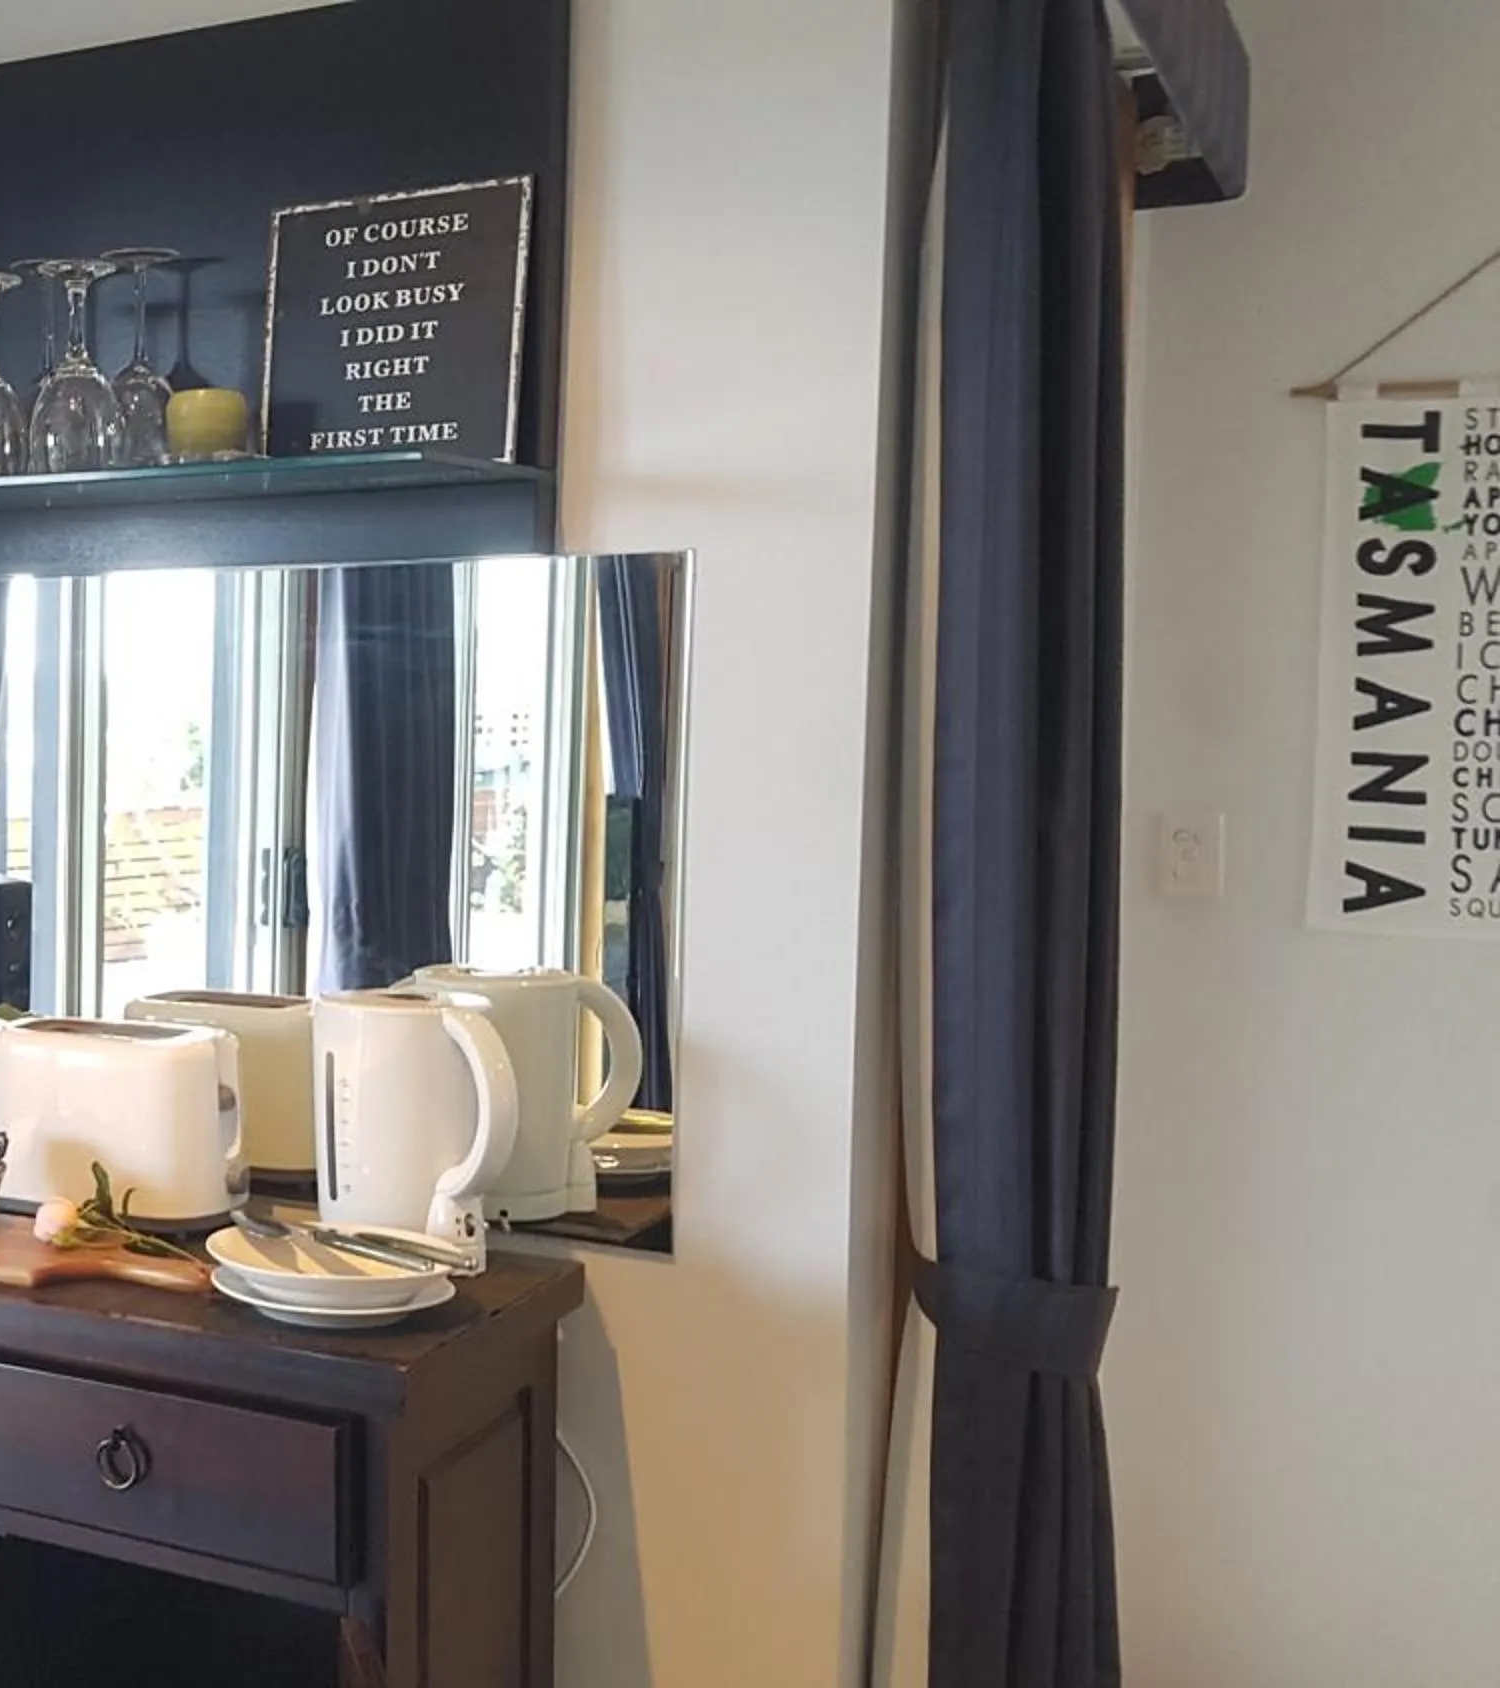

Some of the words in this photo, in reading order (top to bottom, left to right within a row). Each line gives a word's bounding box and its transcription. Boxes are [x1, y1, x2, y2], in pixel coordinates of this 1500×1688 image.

[325, 227, 358, 247] OF
[363, 213, 469, 243] COURSE
[347, 261, 356, 279] I
[363, 251, 441, 277] DON'T
[320, 292, 389, 316] LOOK
[395, 282, 465, 308] BUSY
[340, 329, 350, 347] I
[356, 325, 404, 346] DID
[410, 320, 439, 341] IT
[344, 355, 430, 380] RIGHT
[357, 391, 412, 413] THE
[309, 428, 384, 451] FIRST
[390, 421, 459, 444] TIME
[1343, 411, 1441, 913] TASMANIA
